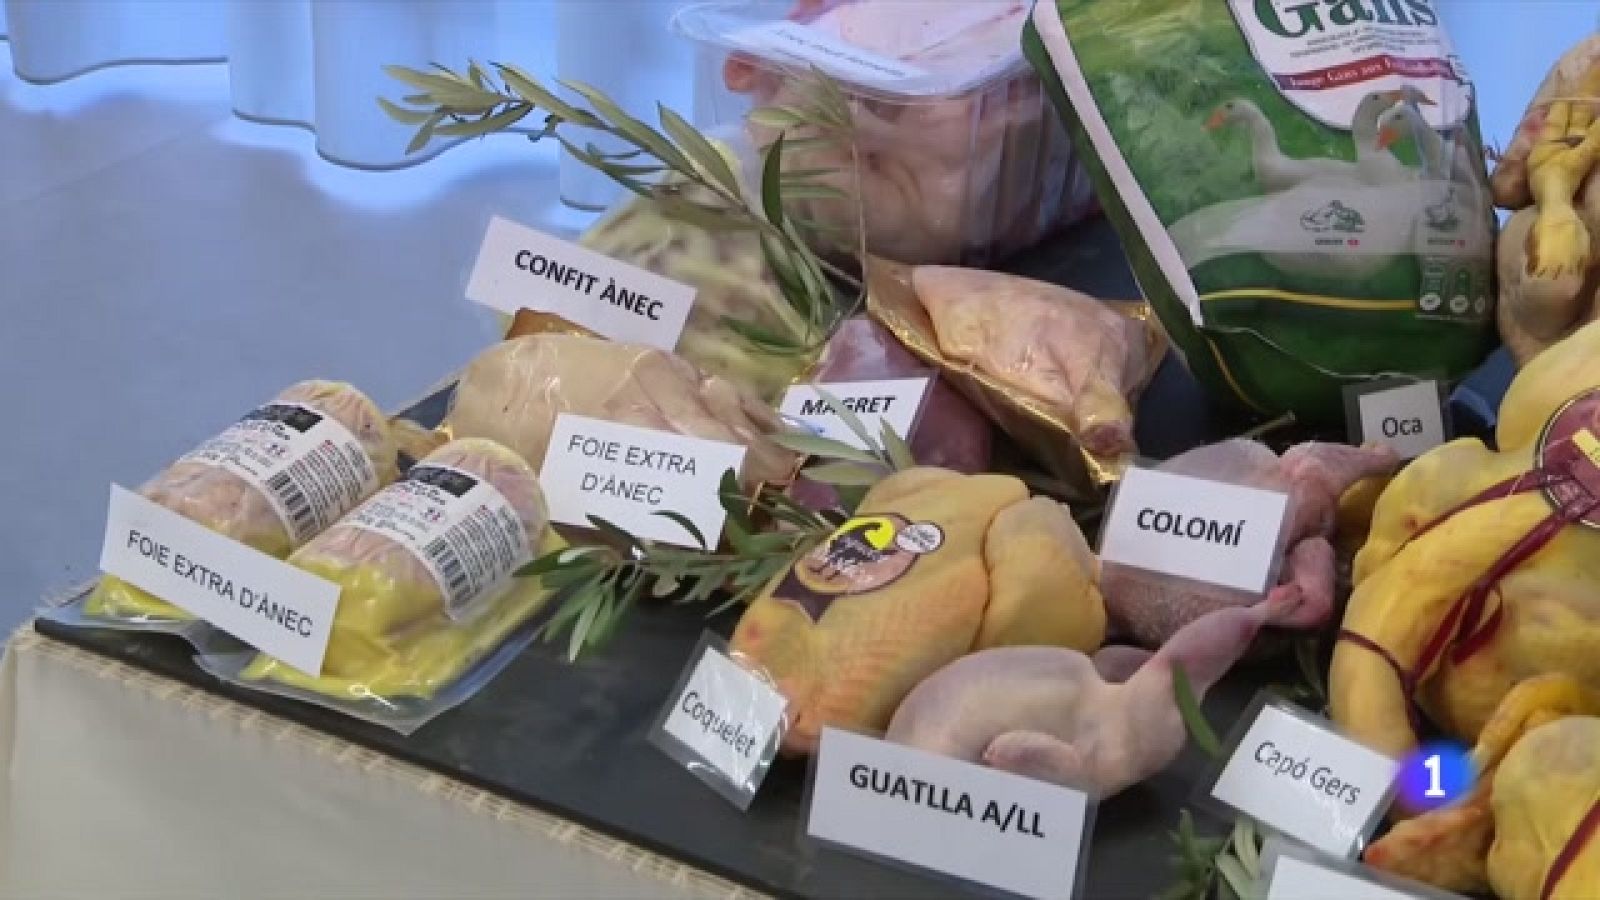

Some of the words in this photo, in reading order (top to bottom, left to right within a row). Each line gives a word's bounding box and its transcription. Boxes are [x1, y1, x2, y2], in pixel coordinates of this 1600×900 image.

[514, 249, 600, 296] CONFIT
[600, 278, 664, 321] ÀNEC
[567, 434, 620, 462] FOIE
[624, 446, 697, 477] EXTRA
[1382, 417, 1424, 438] Oca
[1136, 509, 1246, 547] COLOMÍ
[127, 529, 171, 568] FOIE
[174, 554, 235, 601] EXTRA
[681, 691, 757, 759] Coquelet
[849, 764, 973, 819] GUATLLA
[980, 802, 1045, 839] A/LL
[1254, 740, 1306, 780] Capó
[1309, 767, 1360, 805] Gers
